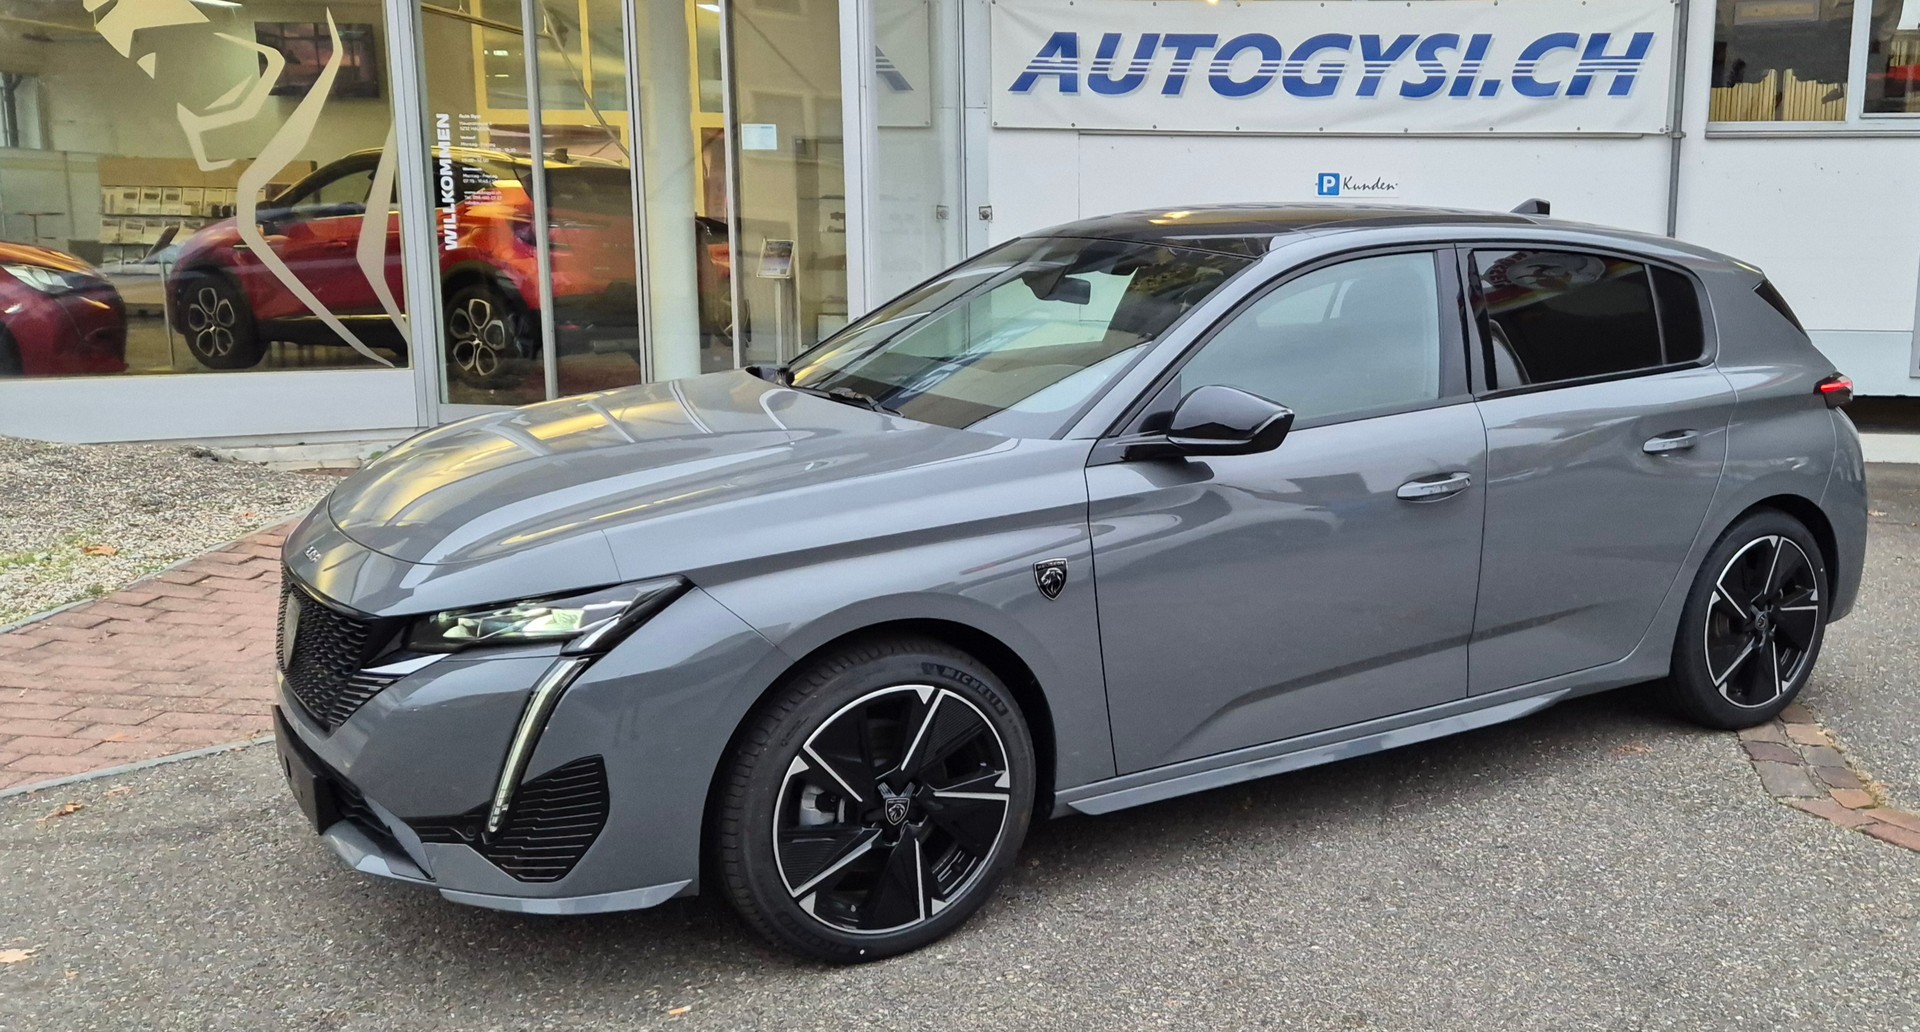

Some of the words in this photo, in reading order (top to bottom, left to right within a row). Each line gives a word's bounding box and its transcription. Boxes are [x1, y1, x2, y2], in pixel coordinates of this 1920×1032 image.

[1007, 31, 1655, 99] AUTOGYSI.CH
[436, 113, 458, 251] WILLKOMMEN
[1322, 175, 1336, 193] P
[1342, 175, 1395, 191] Kunden
[942, 665, 1007, 715] MICHELIN
